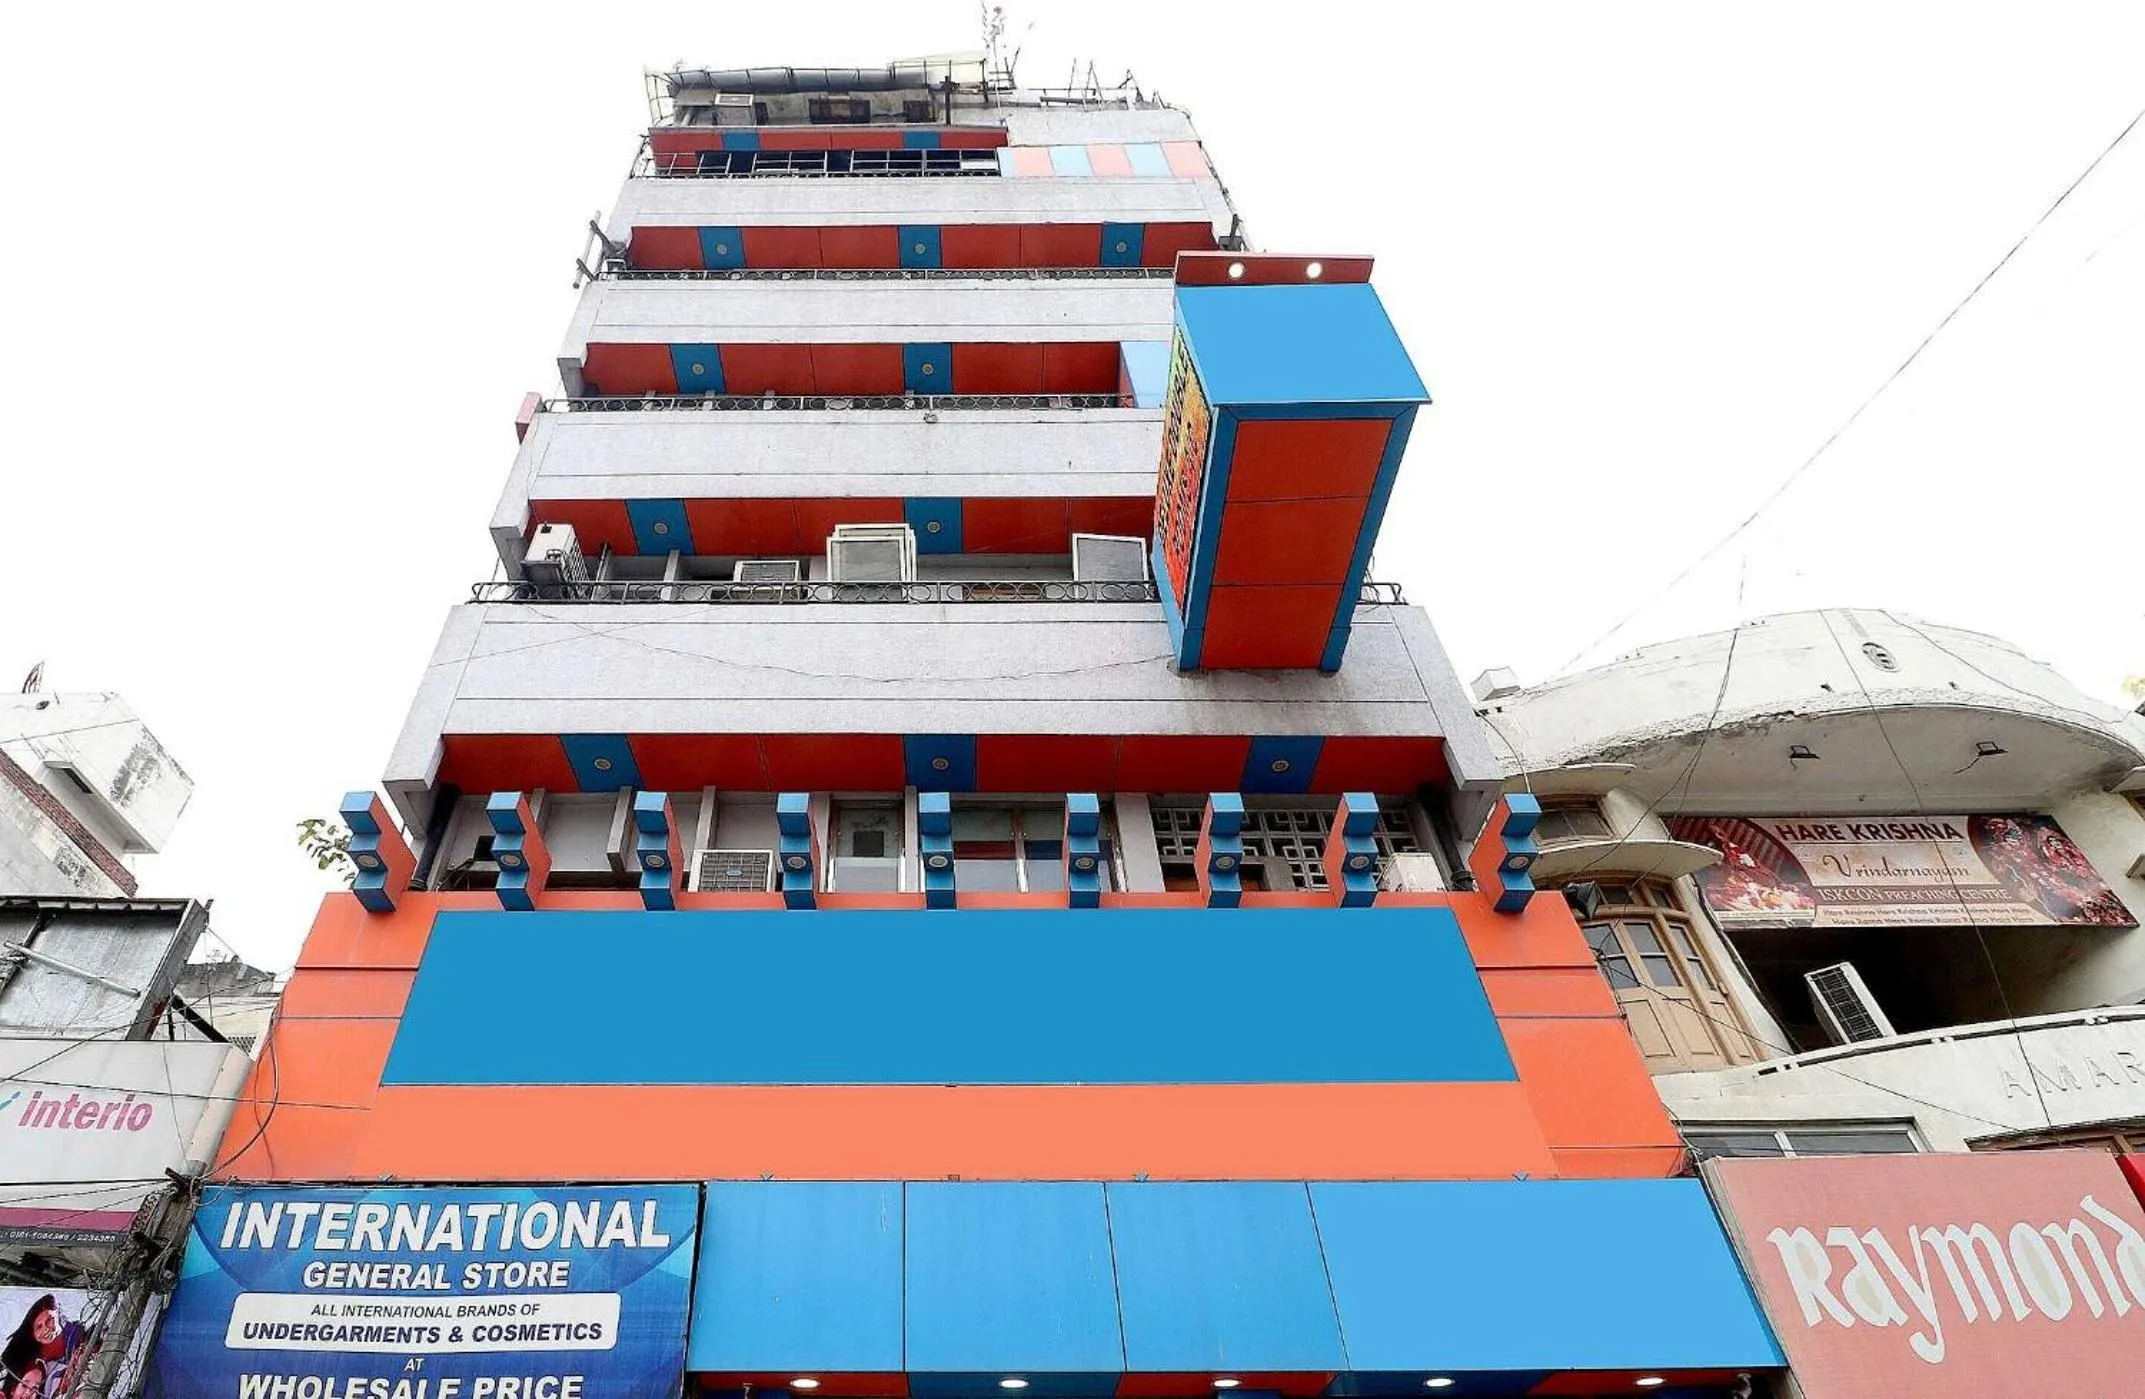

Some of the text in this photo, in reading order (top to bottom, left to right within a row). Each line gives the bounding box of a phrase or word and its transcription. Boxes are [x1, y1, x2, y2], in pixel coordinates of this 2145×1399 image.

[1775, 822, 1965, 841] HARE KRISHNA
[1816, 887, 2013, 901] ISKCON PREACHING CENTRE
[19, 1091, 153, 1131] interio
[219, 1200, 671, 1251] INTERNATIONAL
[302, 1260, 570, 1291] GENERAL STORE
[311, 1303, 540, 1318] ALL INTERNATIONAL BRANDS OF
[243, 1322, 602, 1344] UNDERGARMENTS & COSMETICS
[404, 1358, 424, 1372] AT
[239, 1373, 584, 1399] WHOLESALE PRICE
